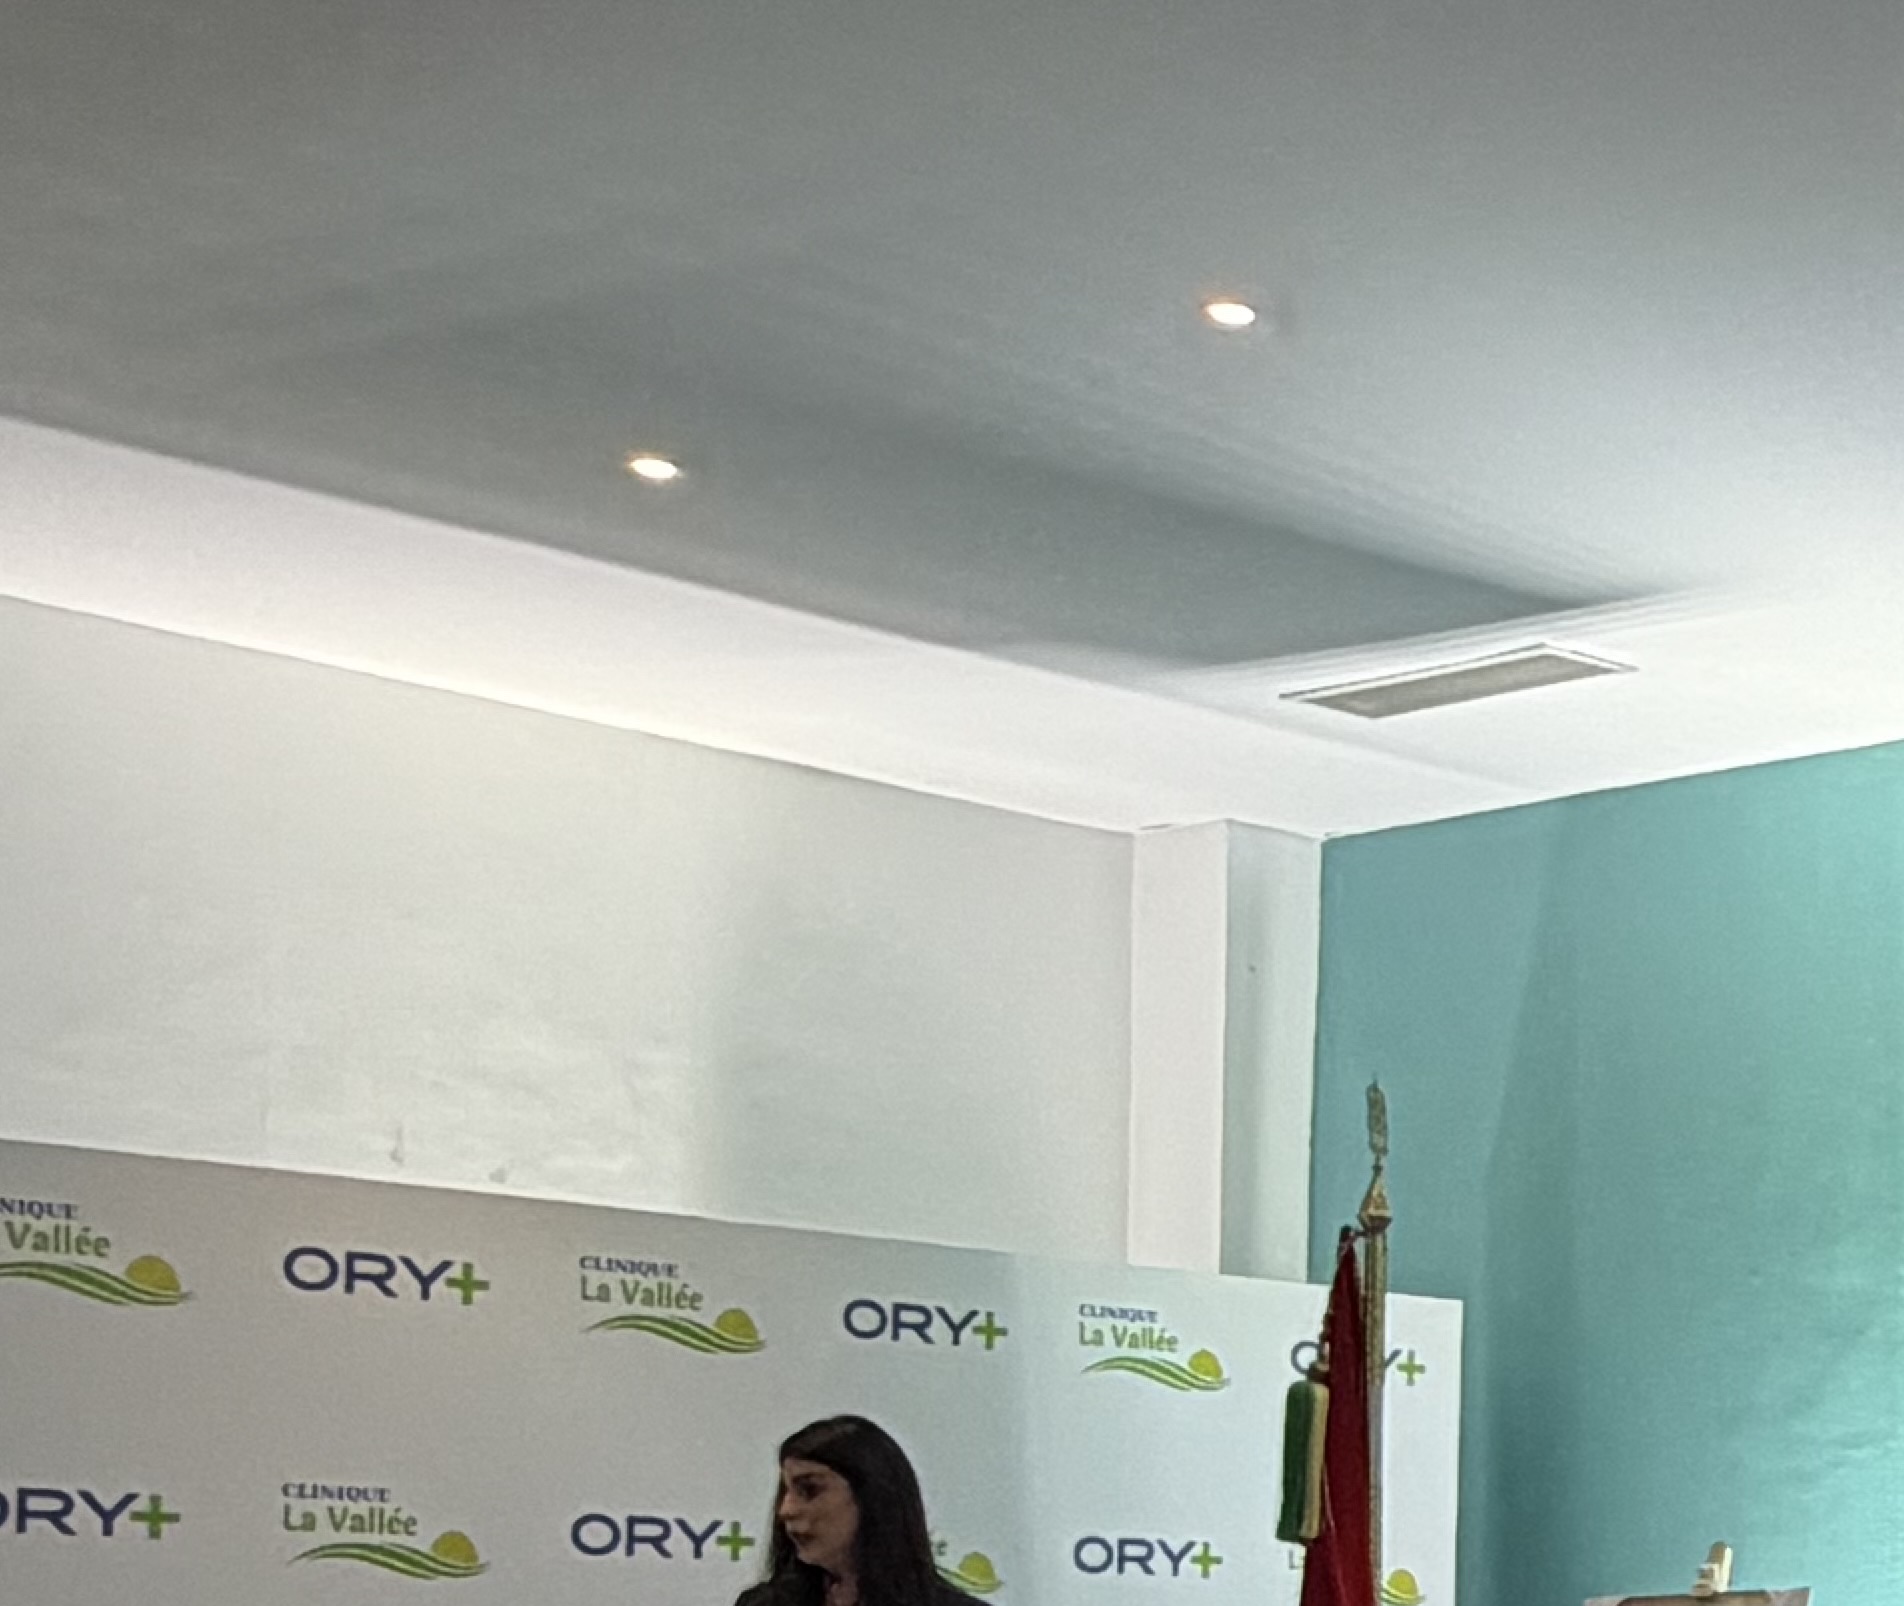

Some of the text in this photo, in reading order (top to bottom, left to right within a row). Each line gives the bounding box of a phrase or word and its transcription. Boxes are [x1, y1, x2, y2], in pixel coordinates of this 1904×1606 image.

[0, 1198, 79, 1220] NIQUE
[4, 1220, 111, 1258] Vallée
[283, 1246, 490, 1306] ORY+
[578, 1255, 680, 1278] CLINIQUE
[580, 1274, 704, 1312] La Vallée
[842, 1298, 1010, 1351] ORY+
[1078, 1321, 1179, 1353] La Vallée
[0, 1487, 181, 1540] RY+
[283, 1503, 418, 1537] La Vallée
[571, 1512, 756, 1562] ORY+
[1073, 1536, 1224, 1579] ORY+
